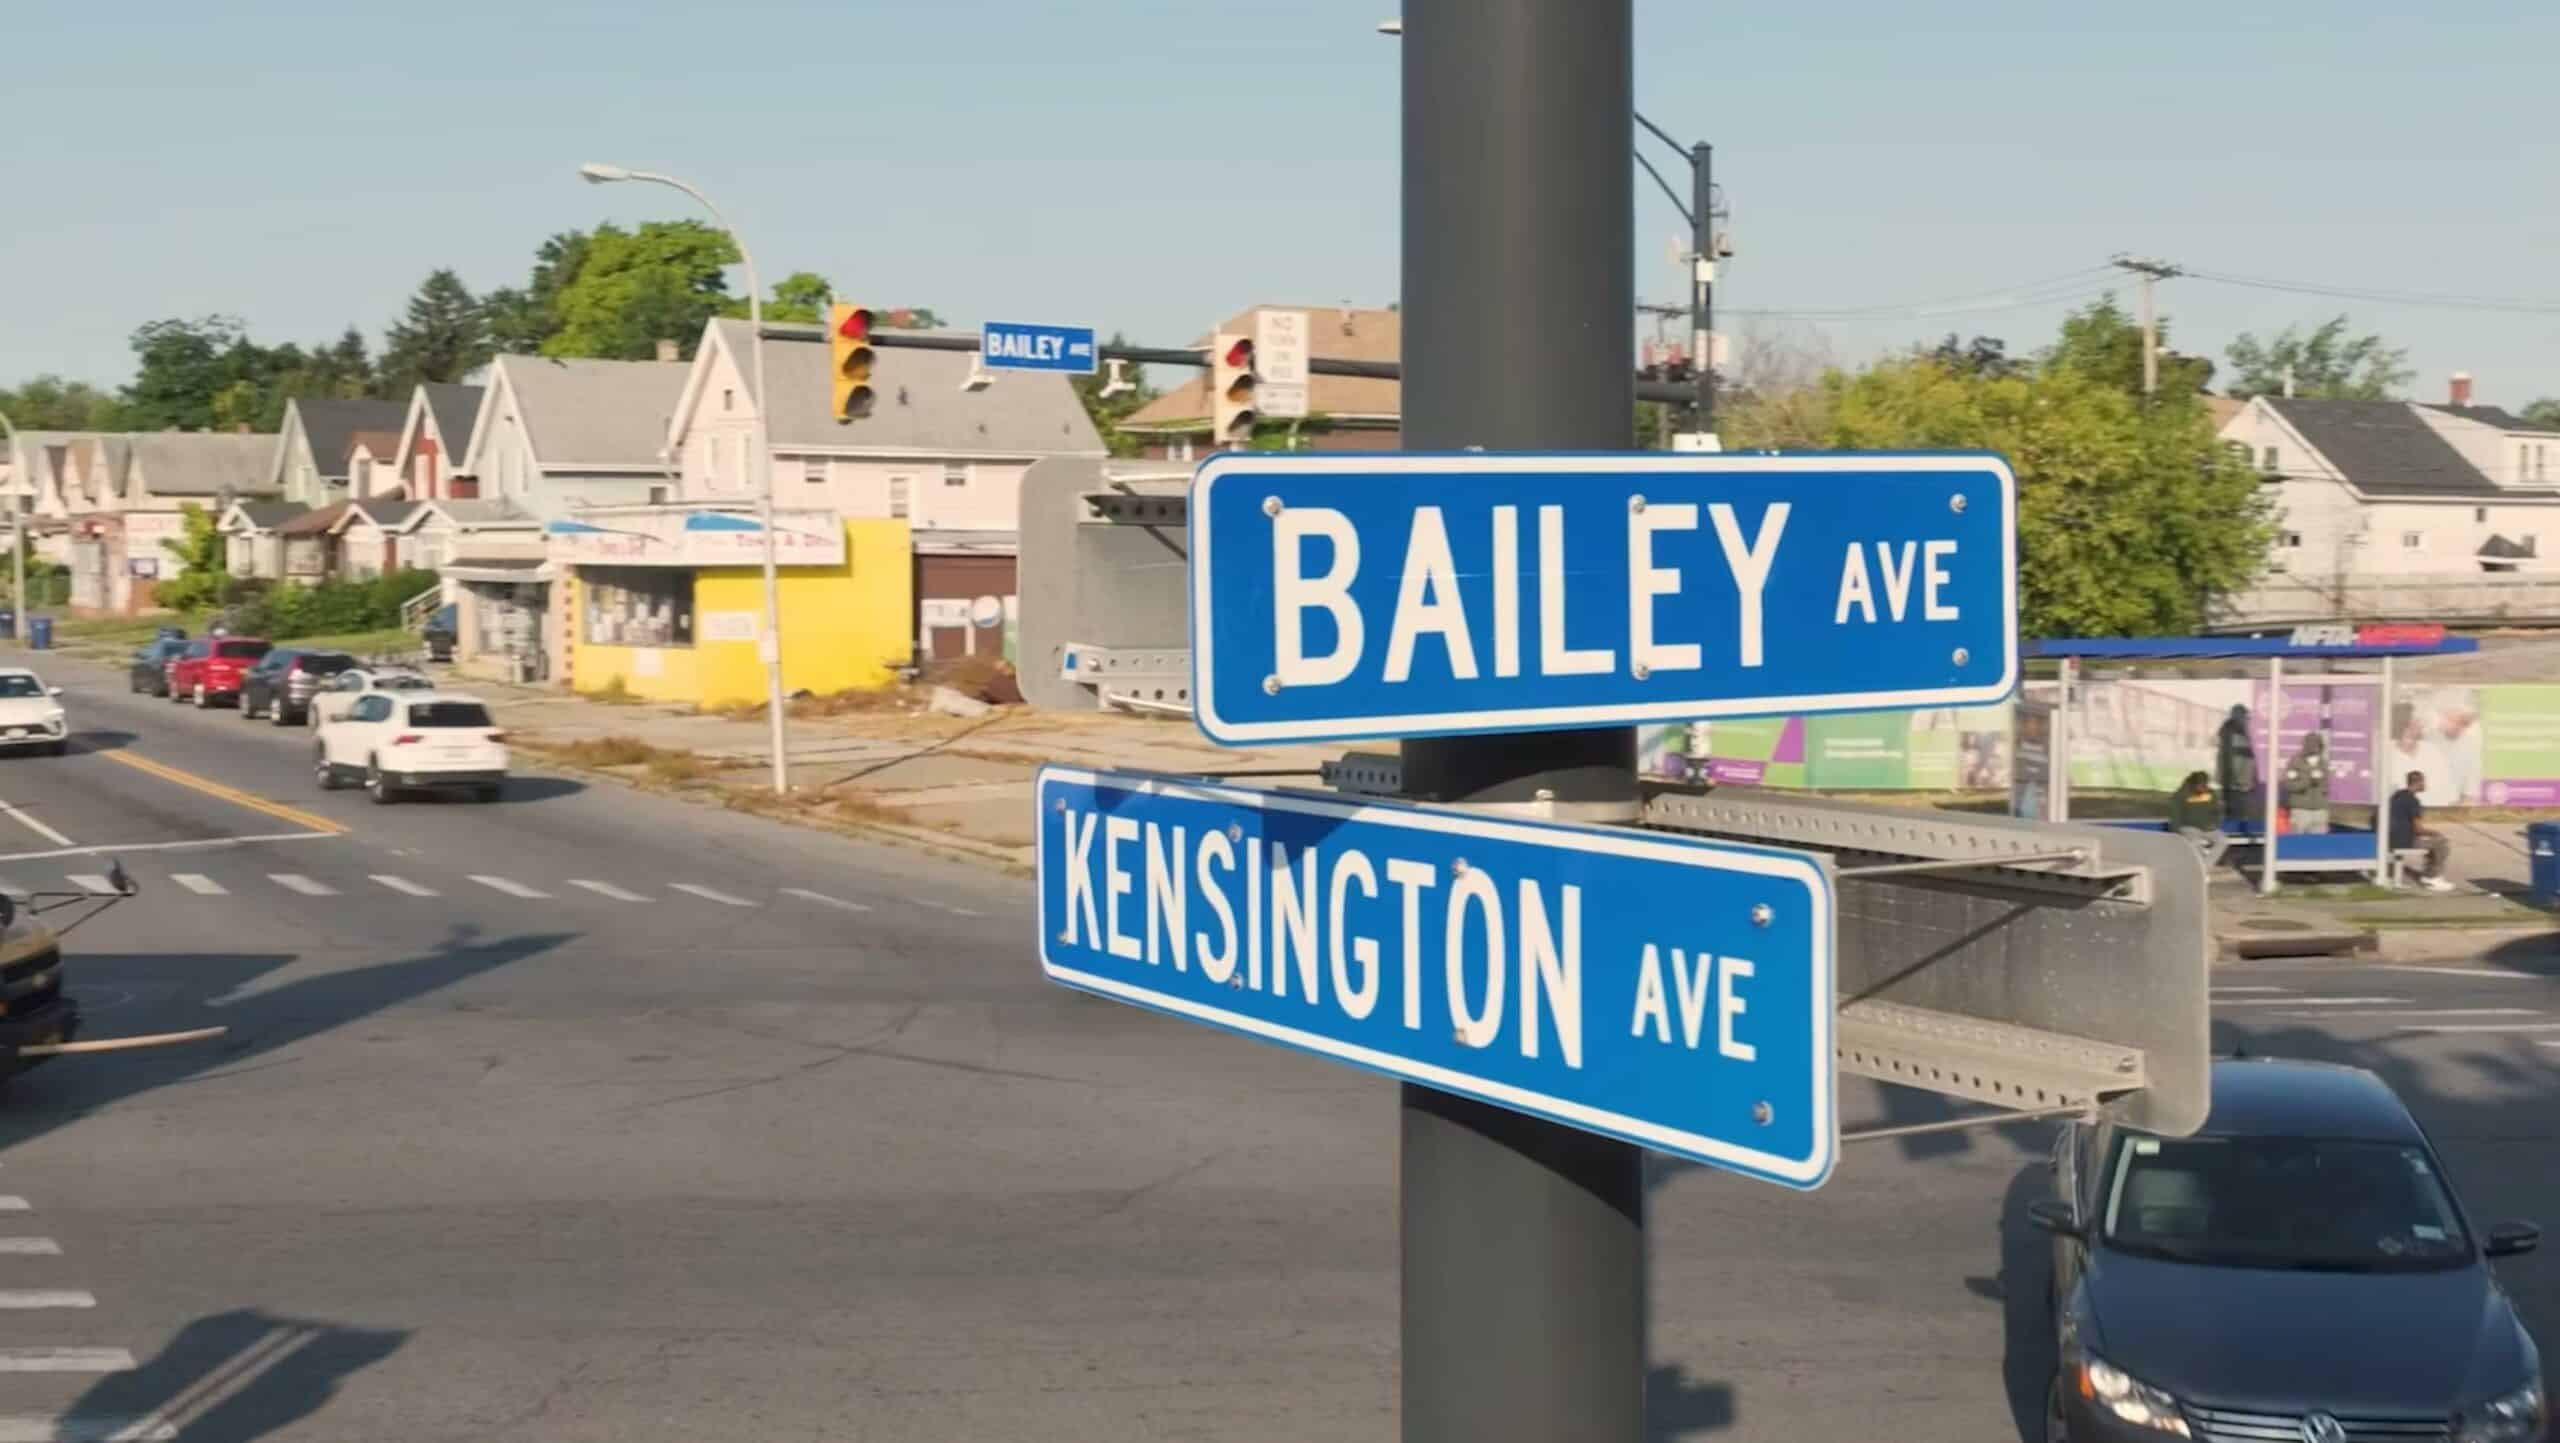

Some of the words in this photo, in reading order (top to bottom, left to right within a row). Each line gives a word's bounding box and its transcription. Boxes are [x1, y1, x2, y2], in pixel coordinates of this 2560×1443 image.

[987, 333, 1064, 360] BAILEY
[1270, 498, 1791, 692] BAILEY
[1835, 540, 1959, 624] AVE
[1061, 809, 1582, 1069] KENSINGTON
[1631, 943, 1756, 1061] AVE
